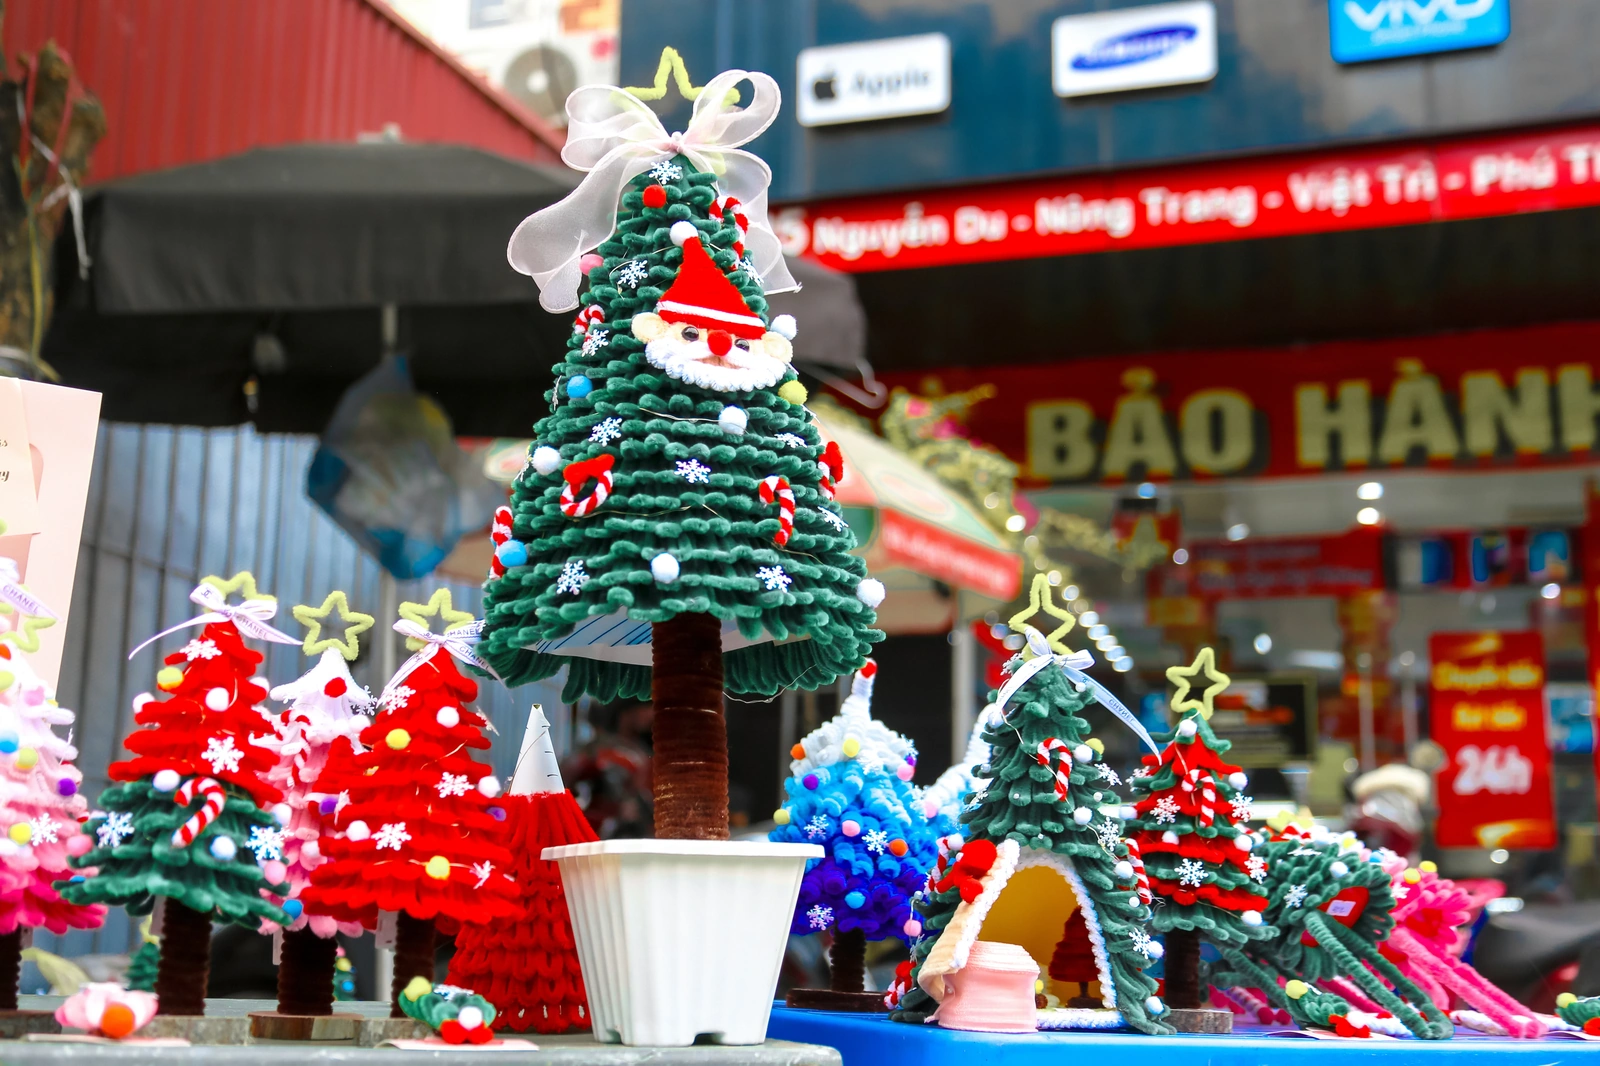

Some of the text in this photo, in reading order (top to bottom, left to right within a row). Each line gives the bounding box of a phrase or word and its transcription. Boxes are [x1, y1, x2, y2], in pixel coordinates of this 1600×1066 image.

[851, 65, 930, 97] Apple
[1035, 193, 1136, 238] Nông
[1138, 186, 1258, 227] Trang
[1287, 166, 1372, 217] Việt
[1376, 158, 1439, 205] Trì
[1470, 146, 1558, 196] Phú
[1026, 367, 1255, 479] BẢO
[3, 584, 39, 615] CHANEL
[459, 645, 489, 670] CHANEL
[1453, 744, 1534, 796] 24h
